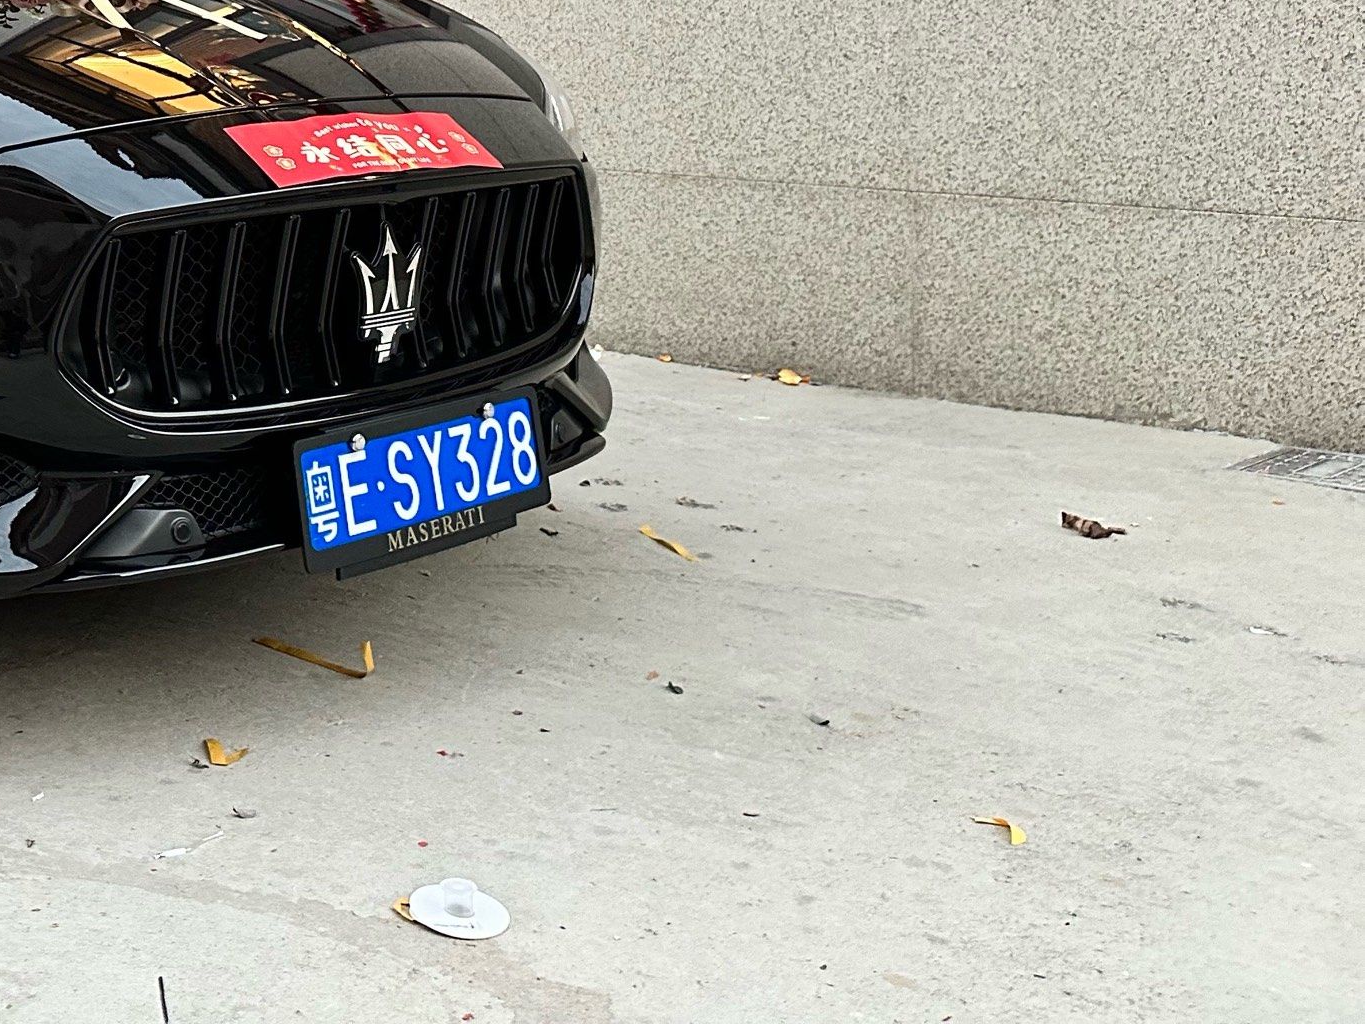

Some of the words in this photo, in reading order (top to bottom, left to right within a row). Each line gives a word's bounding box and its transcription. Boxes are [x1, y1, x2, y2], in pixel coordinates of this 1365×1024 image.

[300, 125, 449, 164] 永结同心
[387, 505, 486, 552] MASERATI
